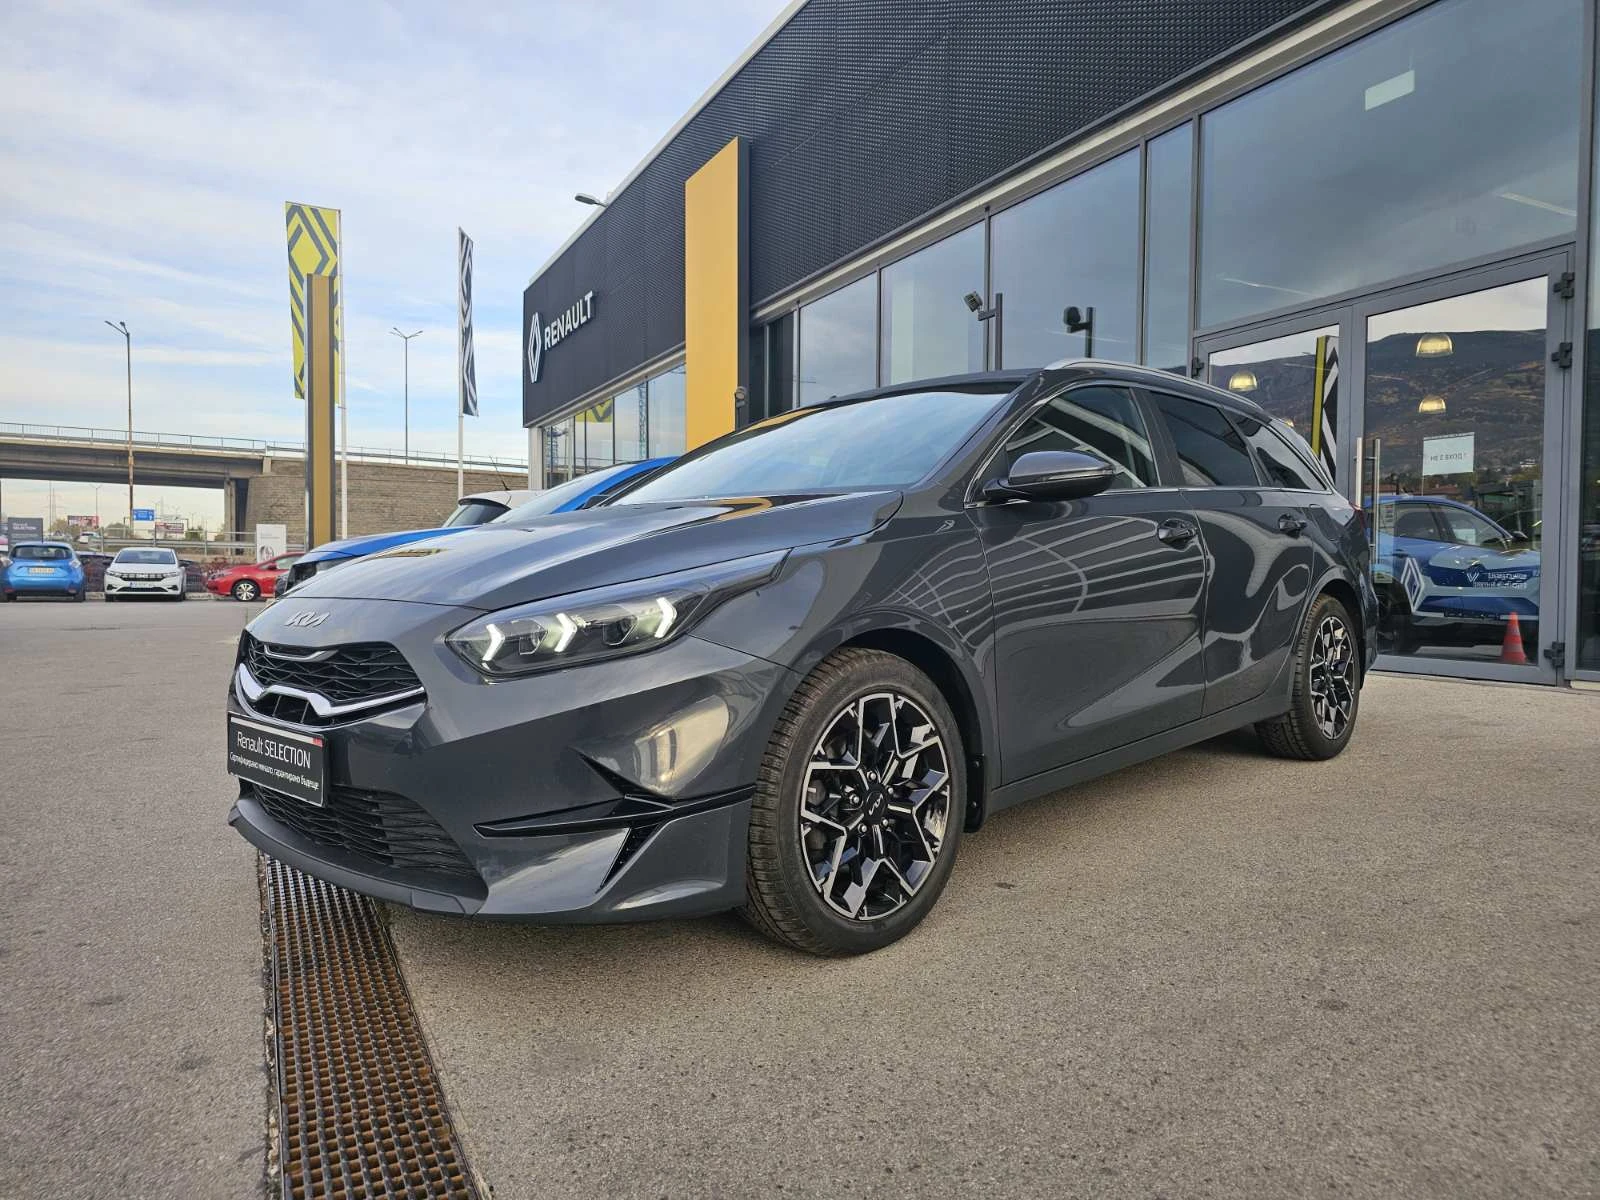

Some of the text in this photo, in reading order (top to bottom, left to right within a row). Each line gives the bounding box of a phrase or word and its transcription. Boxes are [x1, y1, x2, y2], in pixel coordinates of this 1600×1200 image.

[544, 291, 593, 350] RENAULT
[237, 731, 311, 768] Renault SELECTION
